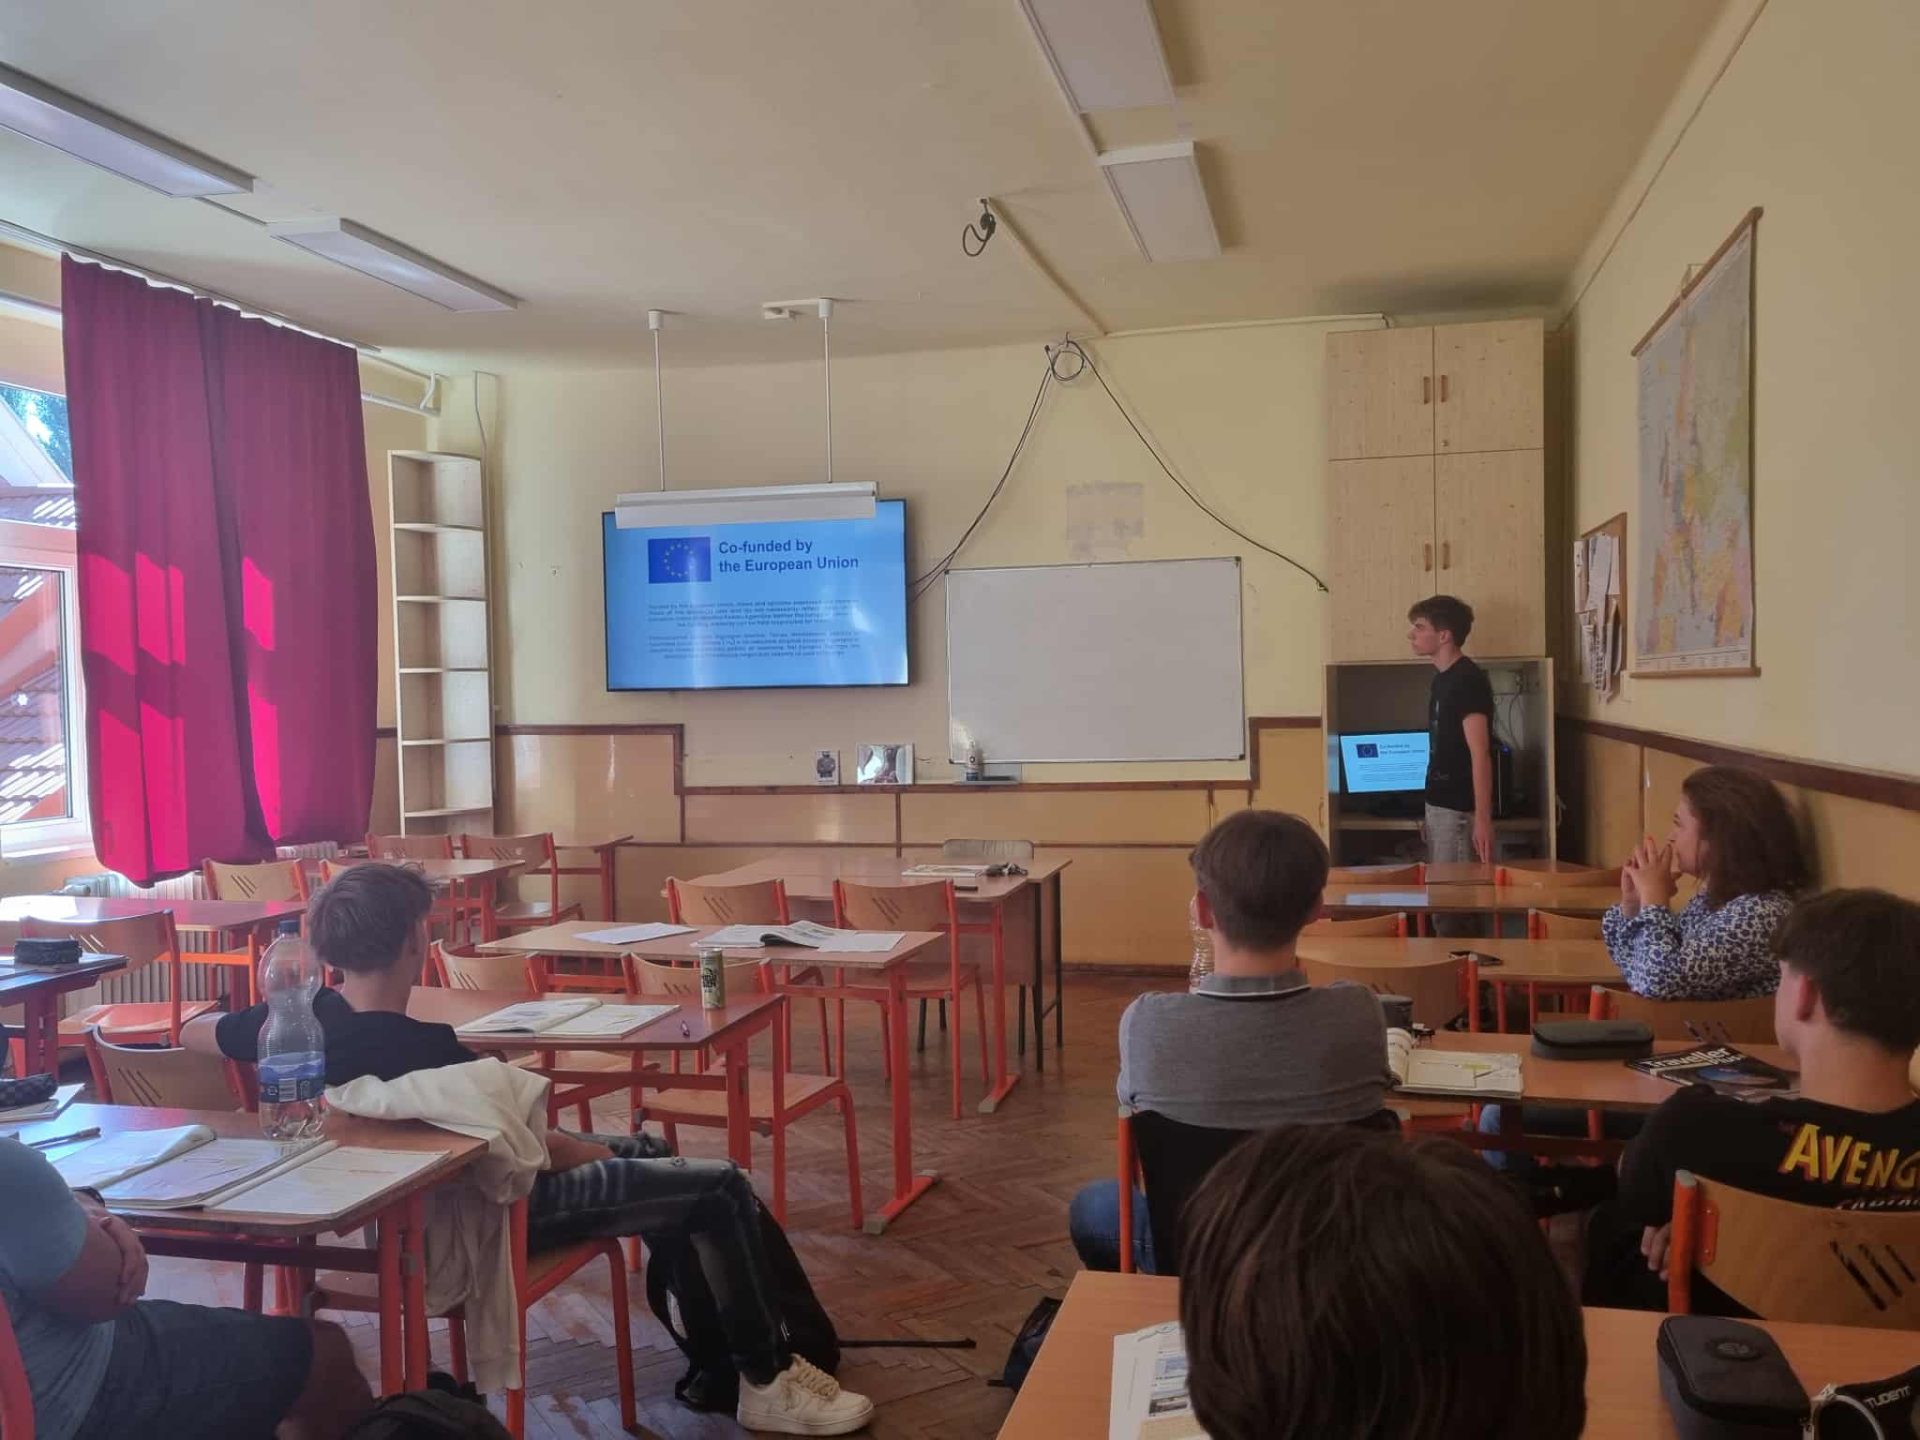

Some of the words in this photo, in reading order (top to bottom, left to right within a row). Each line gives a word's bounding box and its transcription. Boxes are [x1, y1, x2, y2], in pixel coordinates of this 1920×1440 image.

[719, 539, 791, 554] Co-funded
[795, 538, 813, 554] by
[719, 560, 741, 573] the
[745, 558, 812, 574] European
[817, 556, 859, 570] Union
[1641, 1047, 1731, 1068] Traveller
[1862, 1385, 1911, 1409] TUDENT
